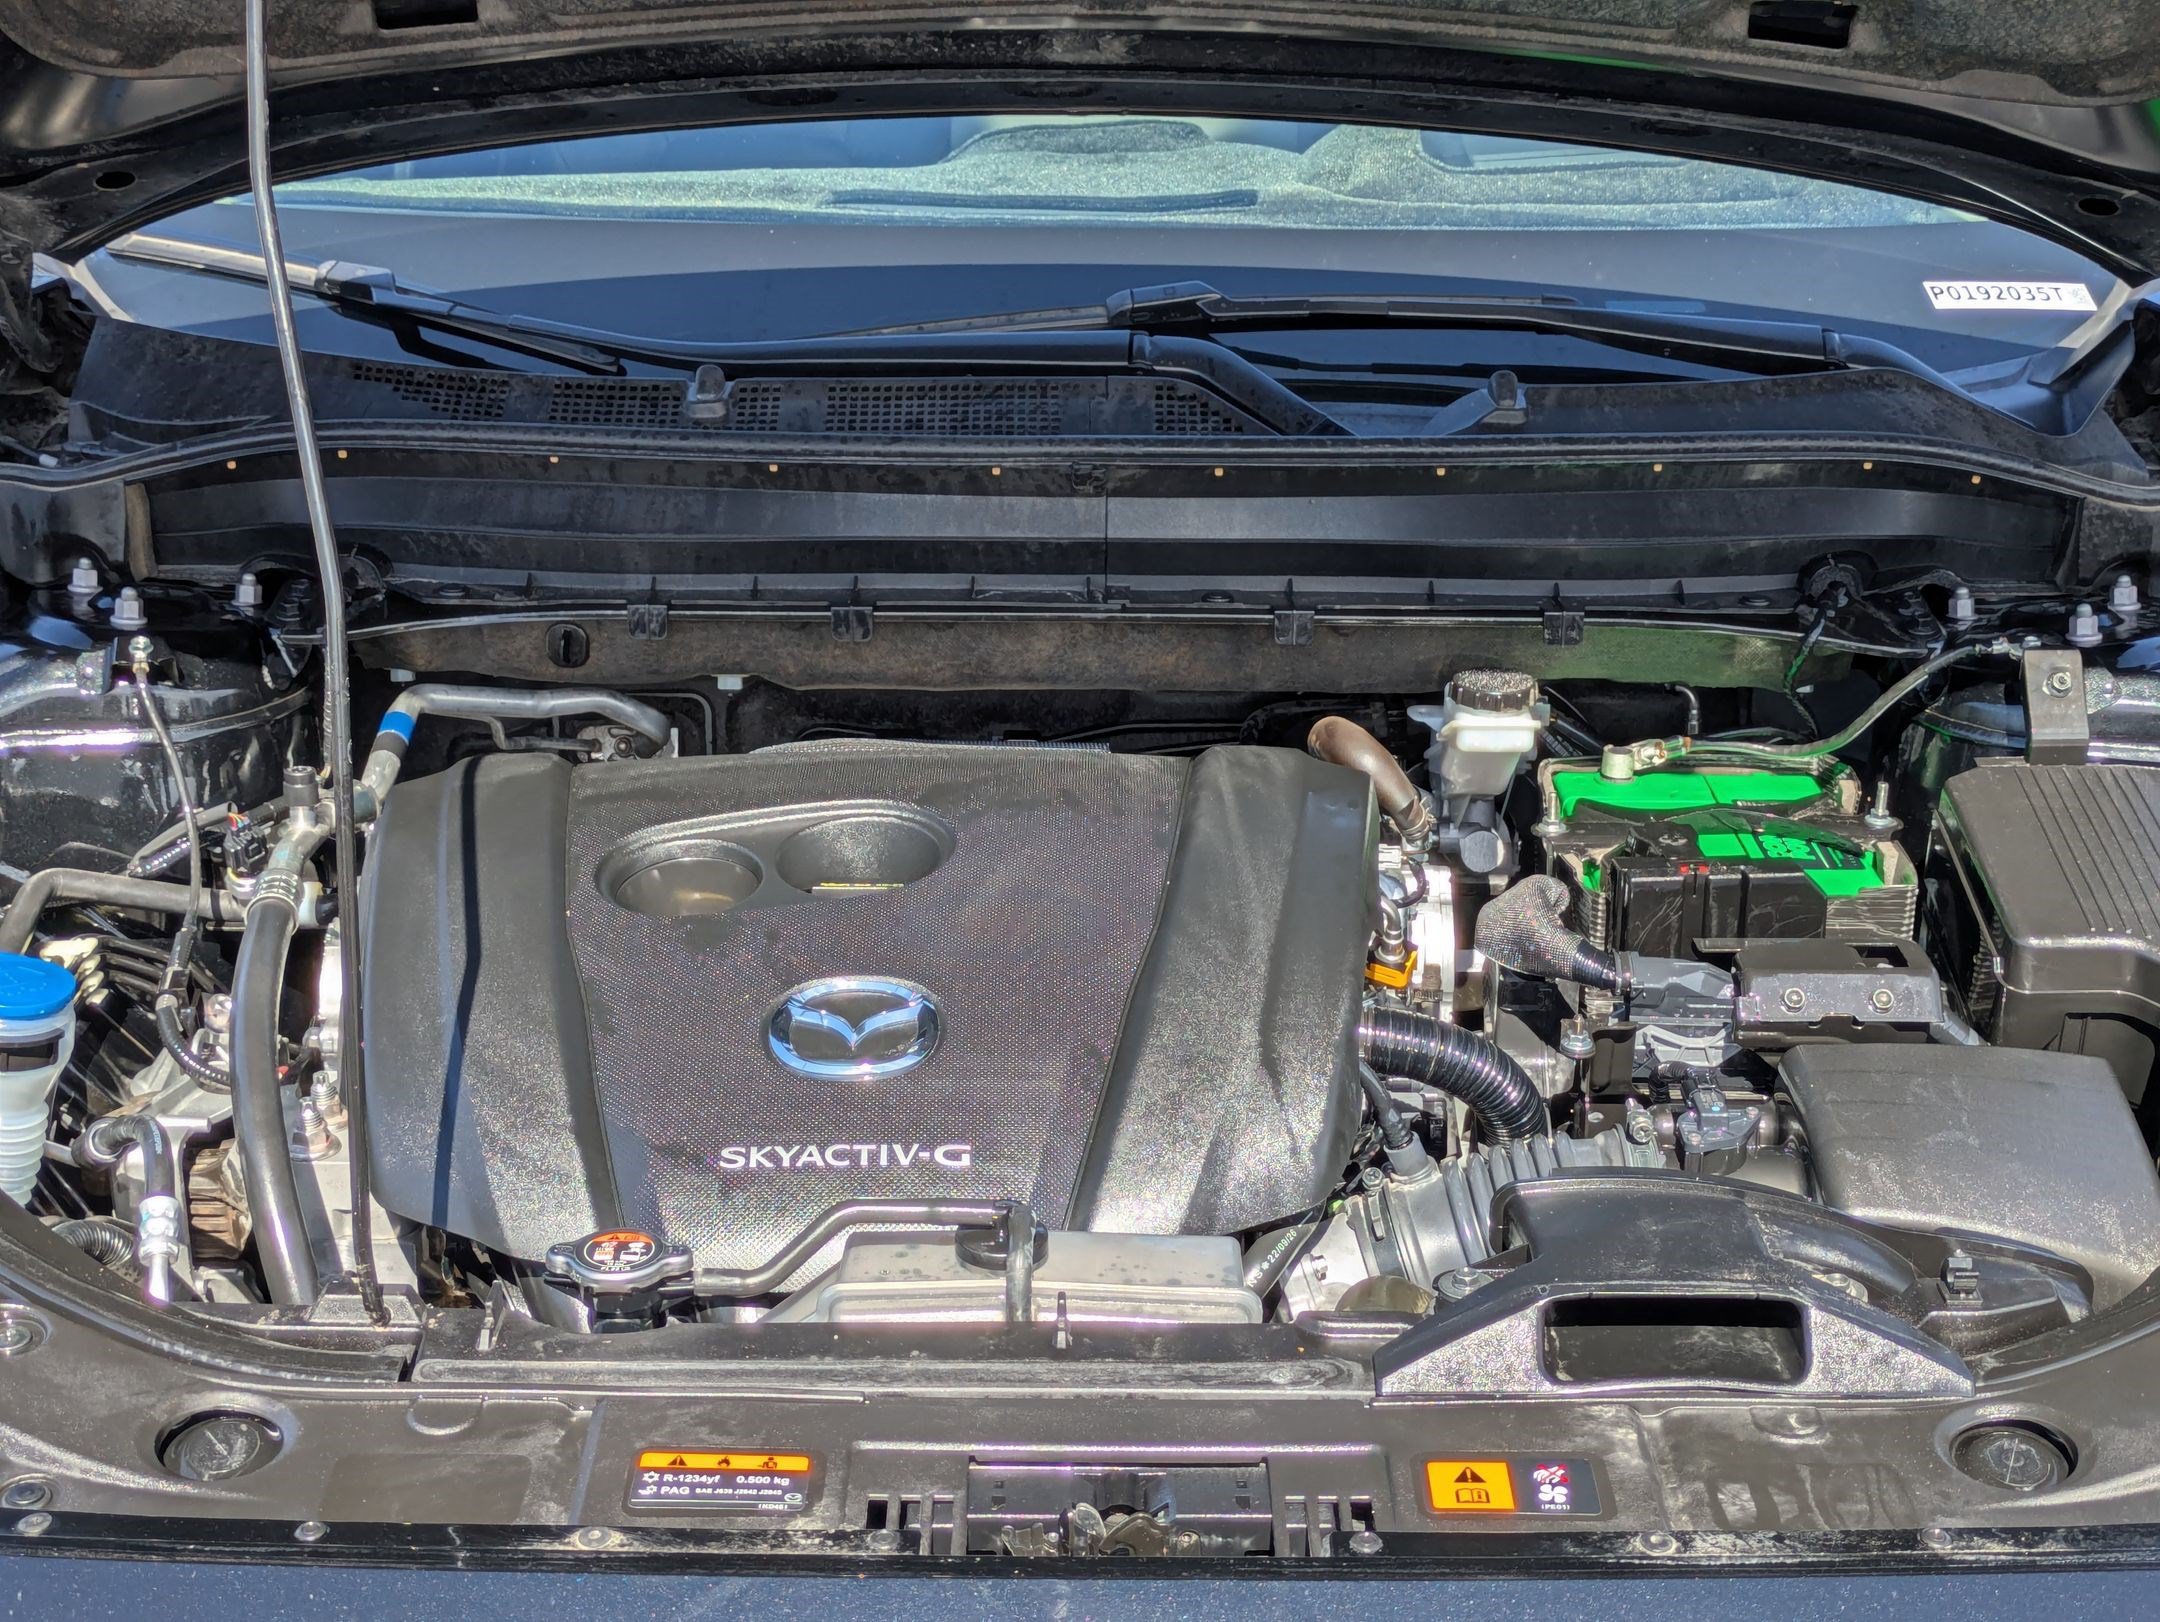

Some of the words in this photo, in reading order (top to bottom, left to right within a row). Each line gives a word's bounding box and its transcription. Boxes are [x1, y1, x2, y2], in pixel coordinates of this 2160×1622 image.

[1929, 285, 2063, 301] P0192035T
[719, 1143, 972, 1169] SKYACTIV-G
[1267, 1229, 1297, 1263] 22/09/26
[662, 1473, 720, 1484] R-1234yf
[736, 1475, 771, 1484] 0.500
[773, 1476, 790, 1486] kg
[660, 1487, 691, 1495] PAG
